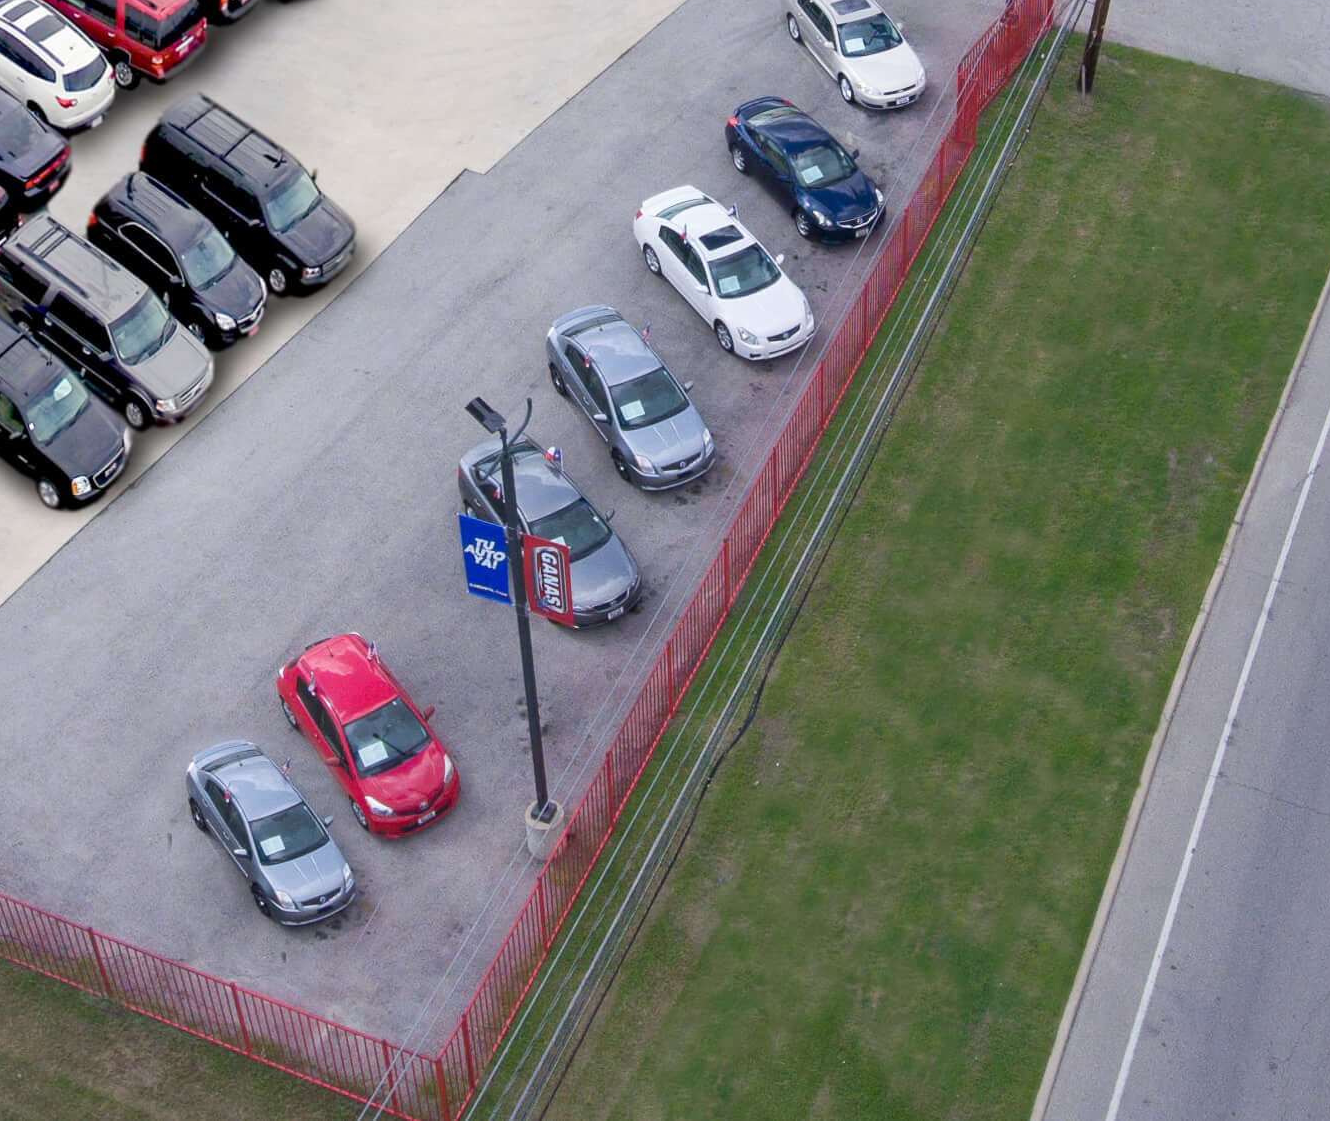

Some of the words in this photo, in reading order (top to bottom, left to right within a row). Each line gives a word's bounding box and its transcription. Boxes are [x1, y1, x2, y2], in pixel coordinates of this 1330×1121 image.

[463, 543, 506, 561] AUTO
[474, 537, 496, 550] TU
[474, 553, 498, 570] YA!
[540, 551, 562, 610] GANAS
